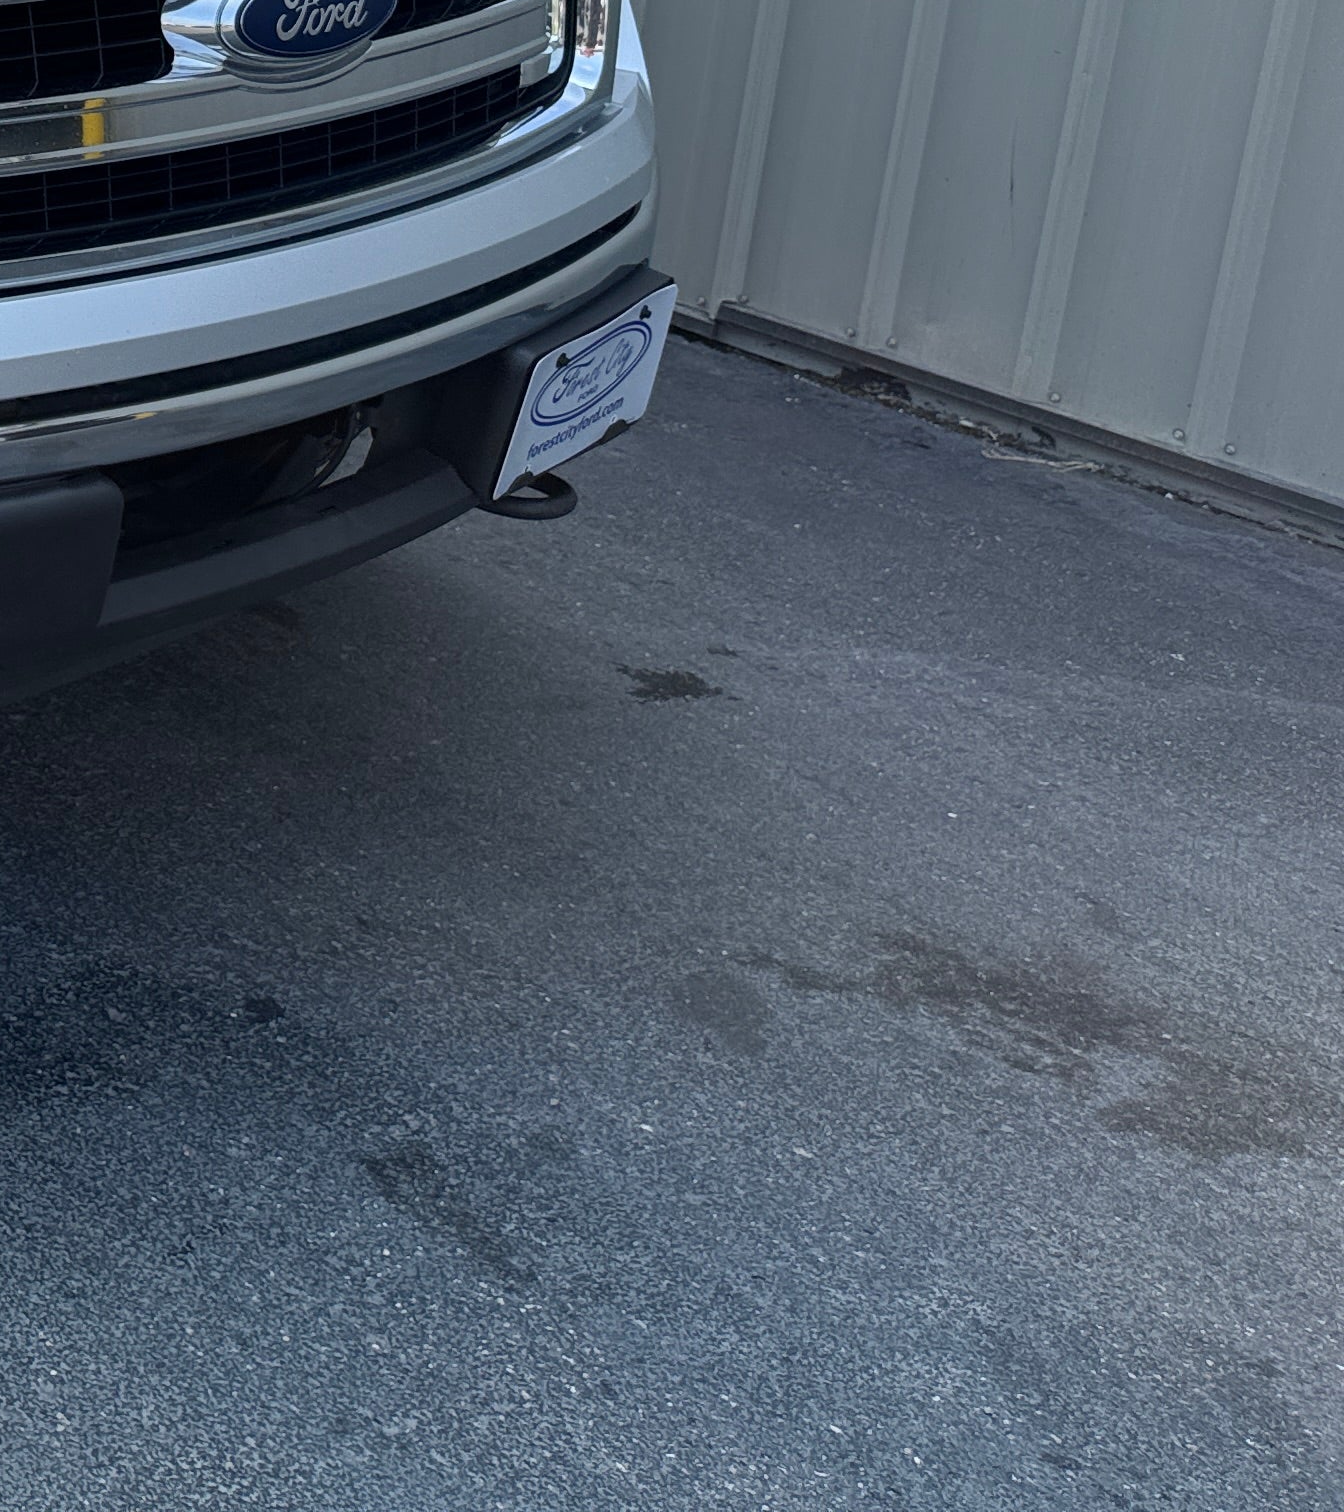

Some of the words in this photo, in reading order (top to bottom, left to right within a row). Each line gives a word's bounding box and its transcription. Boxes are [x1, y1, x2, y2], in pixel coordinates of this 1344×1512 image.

[552, 356, 606, 405] Forest
[605, 337, 636, 378] City
[526, 396, 625, 461] forestcityford.com
